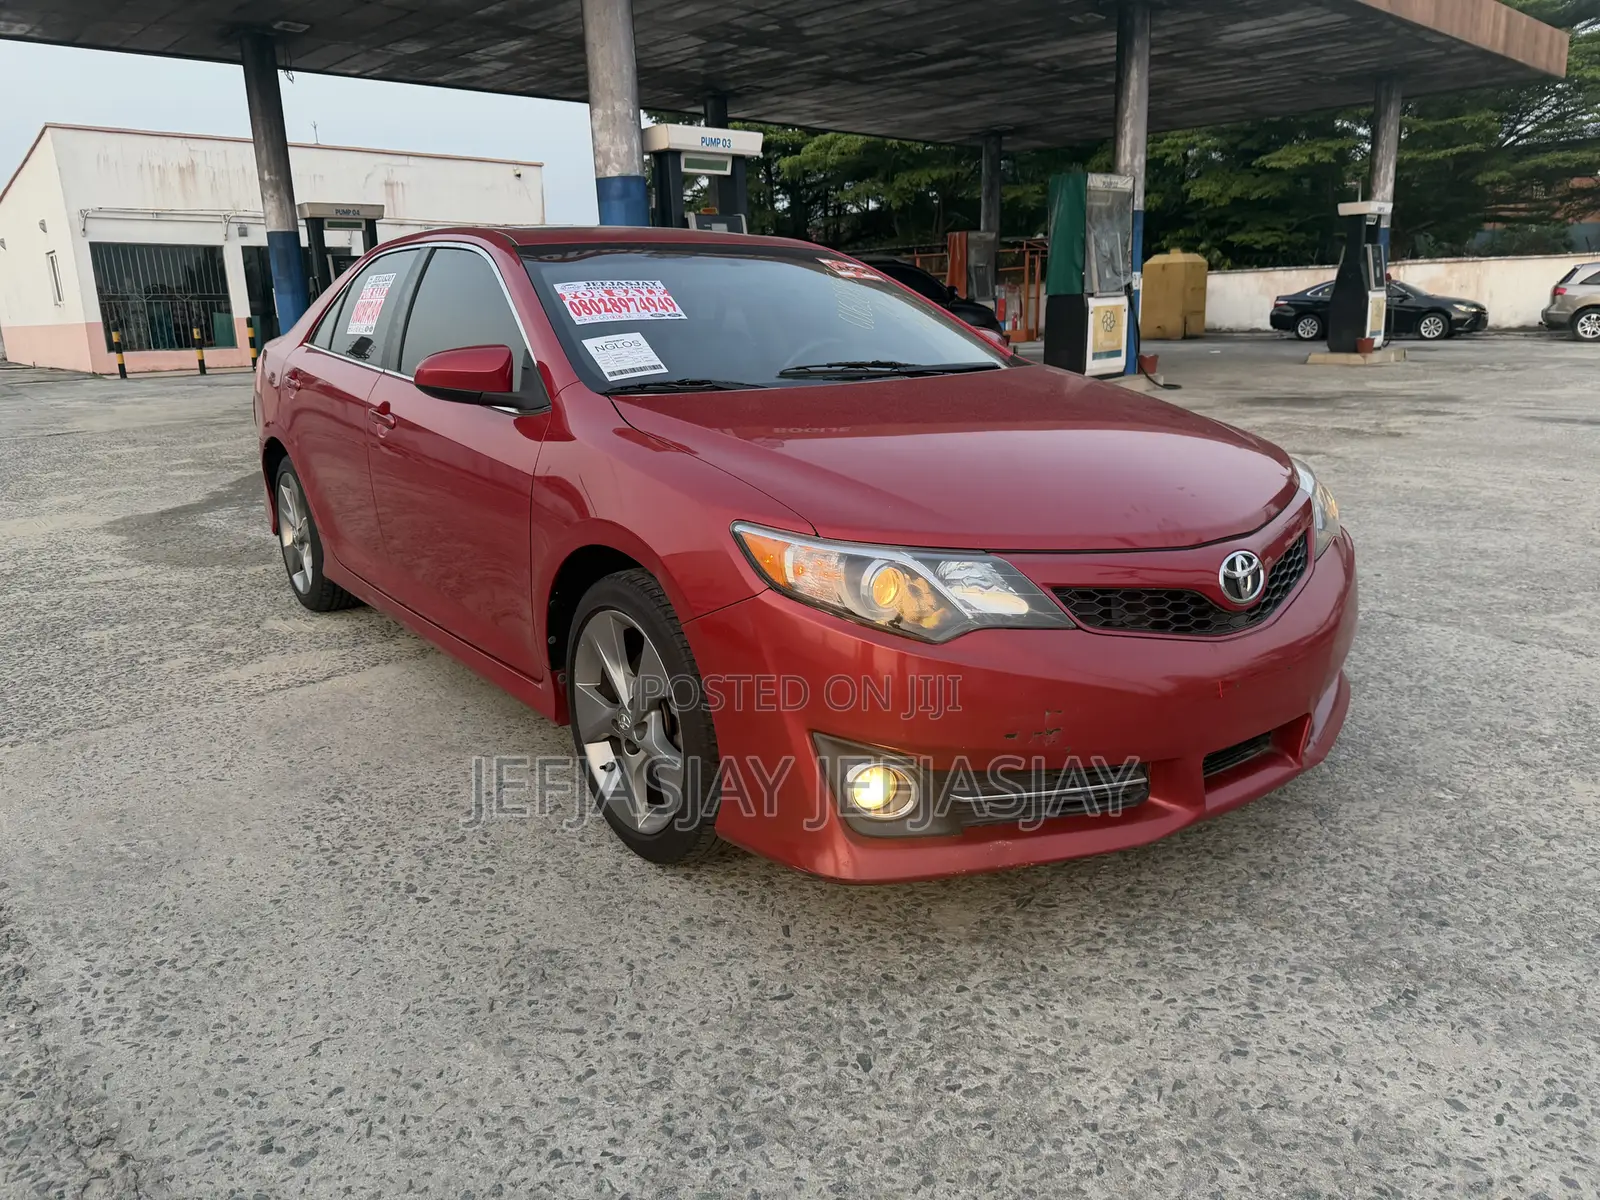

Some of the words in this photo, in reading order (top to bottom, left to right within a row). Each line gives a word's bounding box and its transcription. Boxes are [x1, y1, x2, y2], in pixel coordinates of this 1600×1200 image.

[701, 137, 721, 147] PUMP
[722, 138, 731, 148] 03
[335, 208, 352, 216] PUMP
[568, 296, 677, 317] 08028974949
[594, 340, 642, 353] NGLOS
